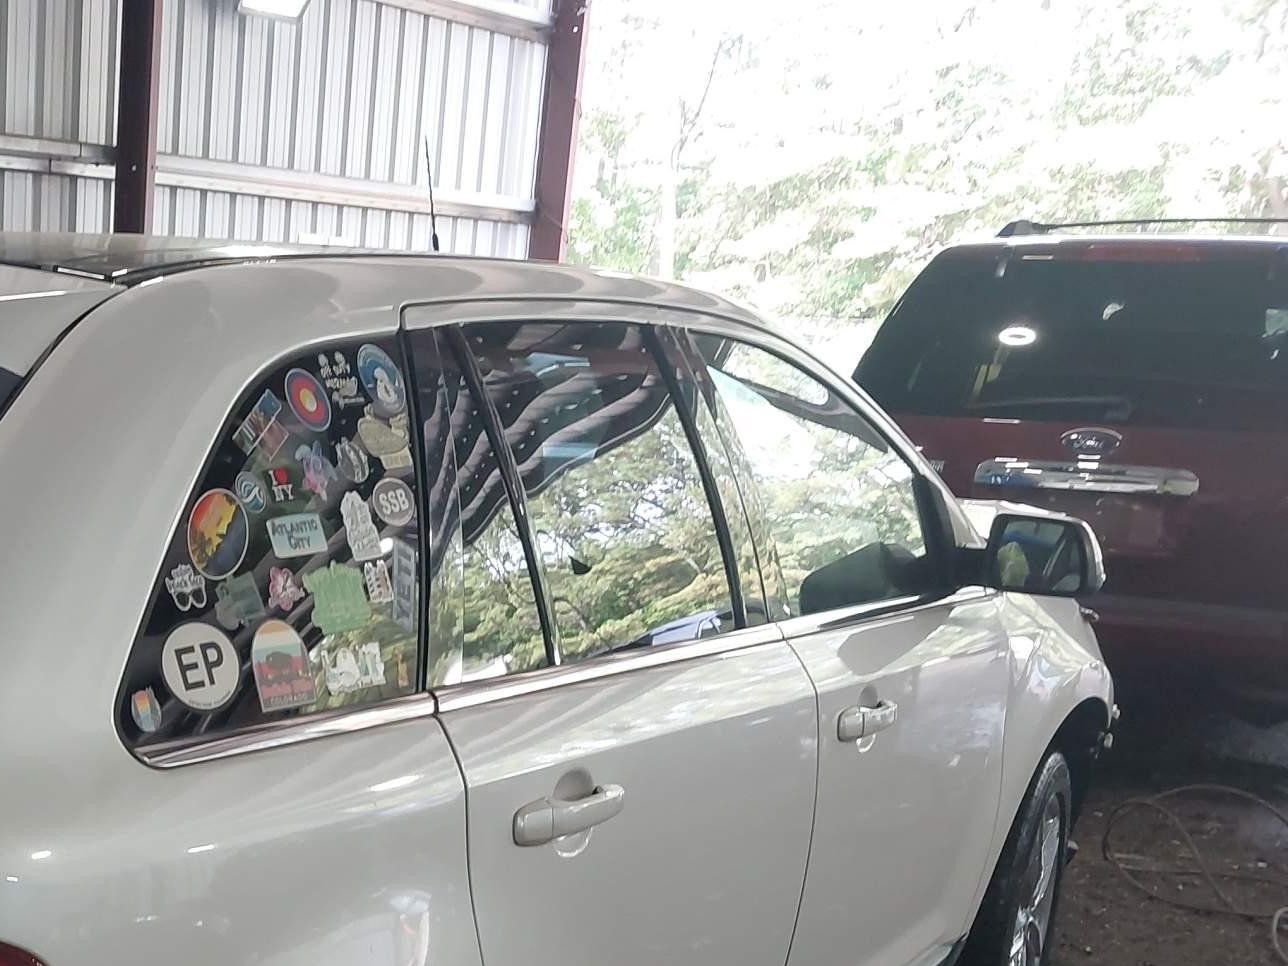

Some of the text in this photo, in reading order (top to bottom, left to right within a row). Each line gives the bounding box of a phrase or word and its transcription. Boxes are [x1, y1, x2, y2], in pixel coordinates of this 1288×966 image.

[272, 483, 294, 501] NY
[378, 488, 410, 516] SSB
[271, 519, 318, 537] ATLANTIC
[288, 535, 311, 550] CITY
[174, 641, 224, 691] EP
